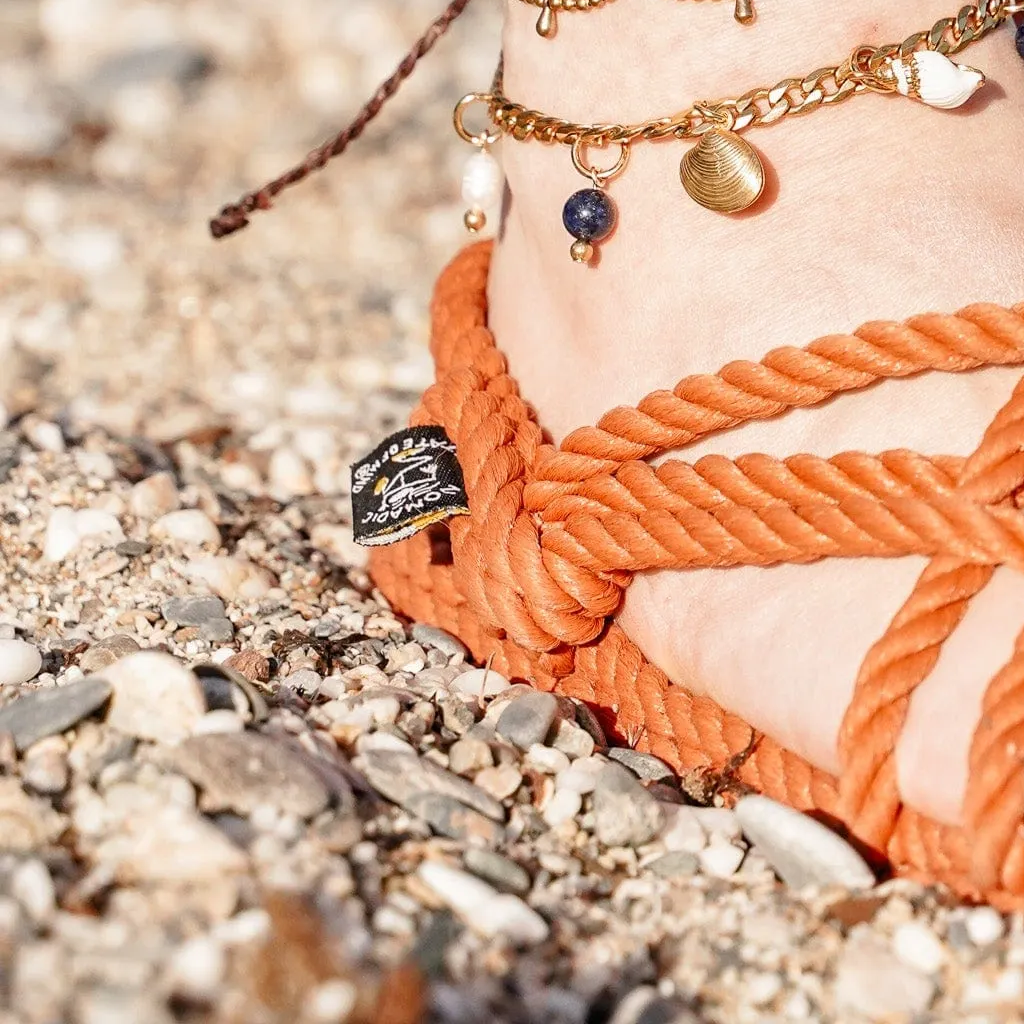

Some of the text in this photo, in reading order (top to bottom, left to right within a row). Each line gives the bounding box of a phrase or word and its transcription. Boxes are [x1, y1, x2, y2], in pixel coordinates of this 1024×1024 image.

[382, 443, 399, 463] OF
[403, 437, 457, 456] TATE
[362, 484, 460, 524] NOMADIC
